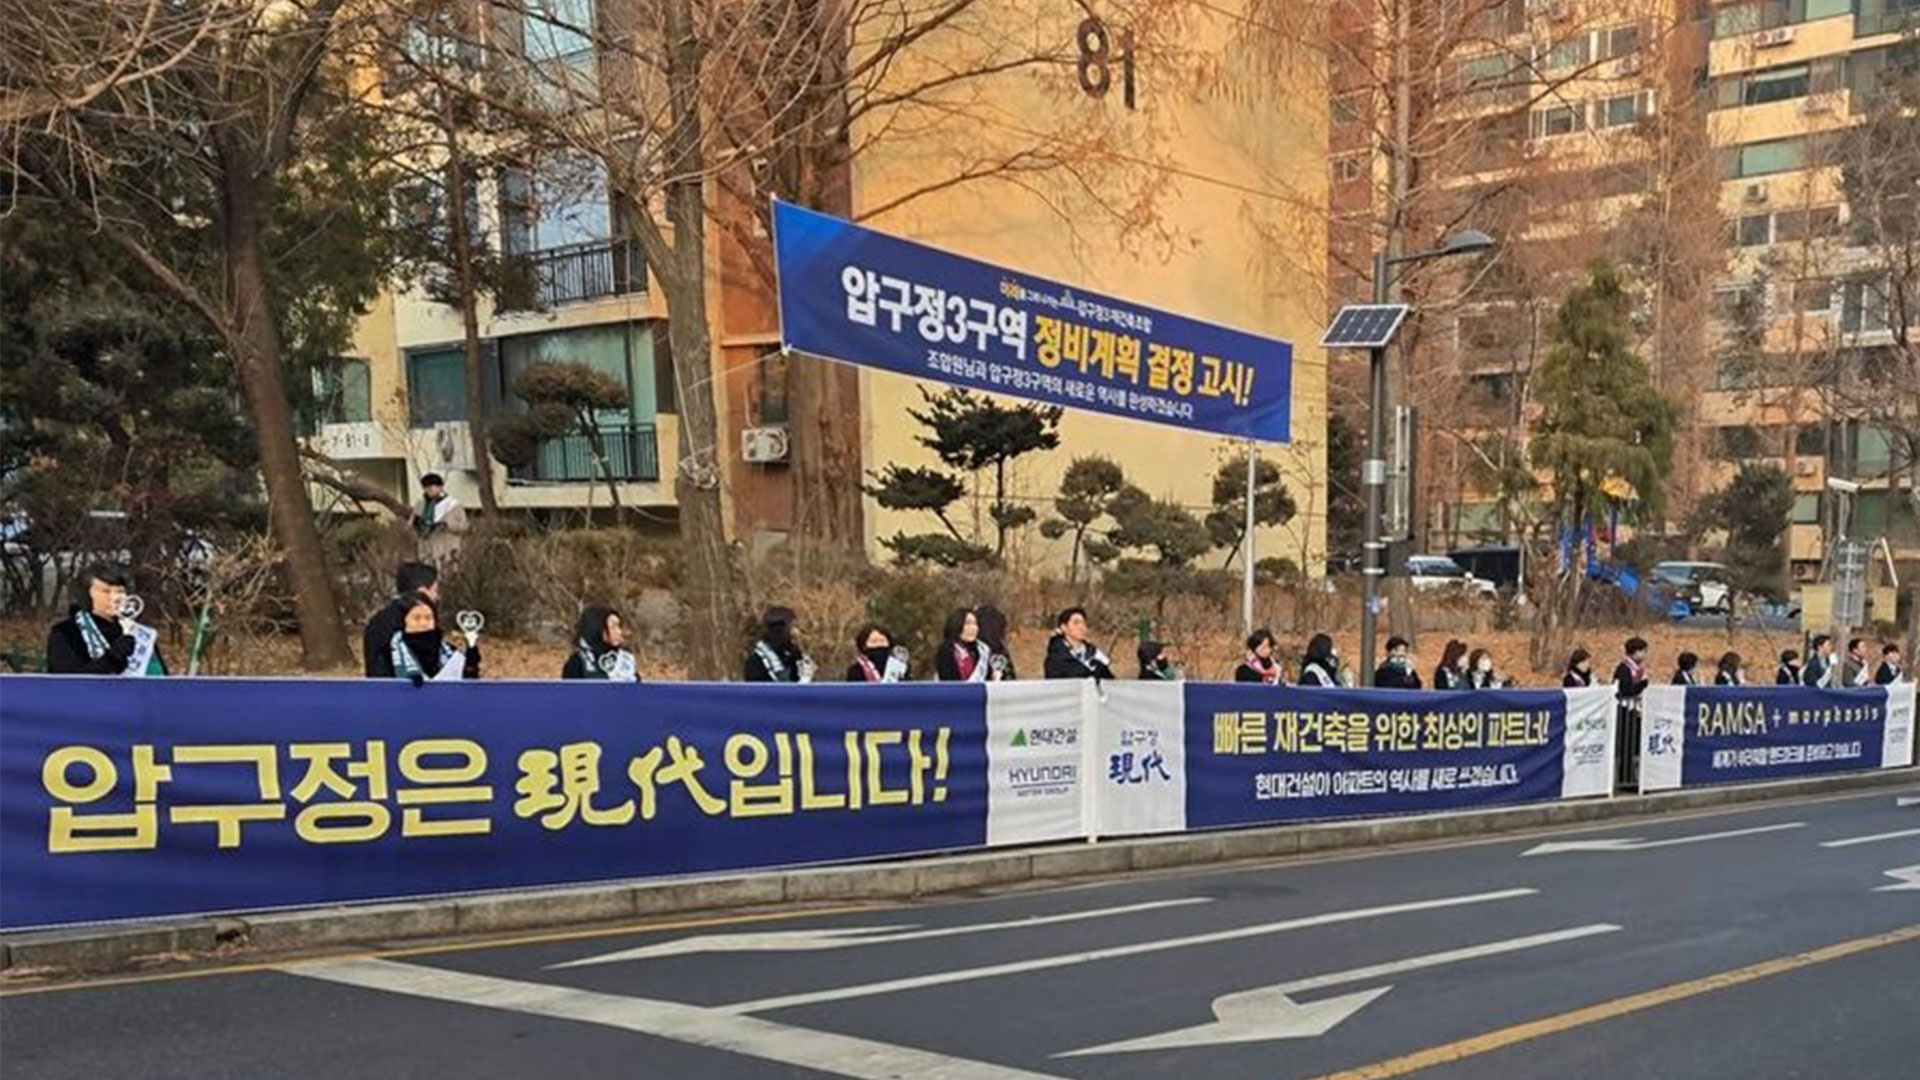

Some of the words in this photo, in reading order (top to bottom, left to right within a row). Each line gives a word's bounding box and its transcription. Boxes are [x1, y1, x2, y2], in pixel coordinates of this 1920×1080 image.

[1077, 17, 1135, 110] 81
[841, 265, 1027, 361] 압구정3구역
[1034, 315, 1141, 384] 정비계획
[1148, 342, 1195, 396] 결정
[1198, 355, 1255, 407] 고시!
[989, 362, 1063, 395] 압구정3구역의
[1213, 712, 1267, 755] 빠른
[1273, 711, 1371, 753] 재건축을
[1375, 713, 1421, 752] 위한
[1423, 711, 1483, 751] 최상의
[1488, 710, 1550, 748] 파트너!
[1696, 702, 1768, 737] RAMSA
[1029, 728, 1077, 746] 현대건설
[1120, 729, 1158, 746] 압구정
[1009, 765, 1077, 783] HYUNDAI
[1109, 750, 1171, 784] 現代
[1255, 773, 1331, 800] 현대건설이
[1332, 769, 1388, 795] 아파트의
[1389, 768, 1430, 792] 역사를
[41, 738, 494, 853] 압구정은
